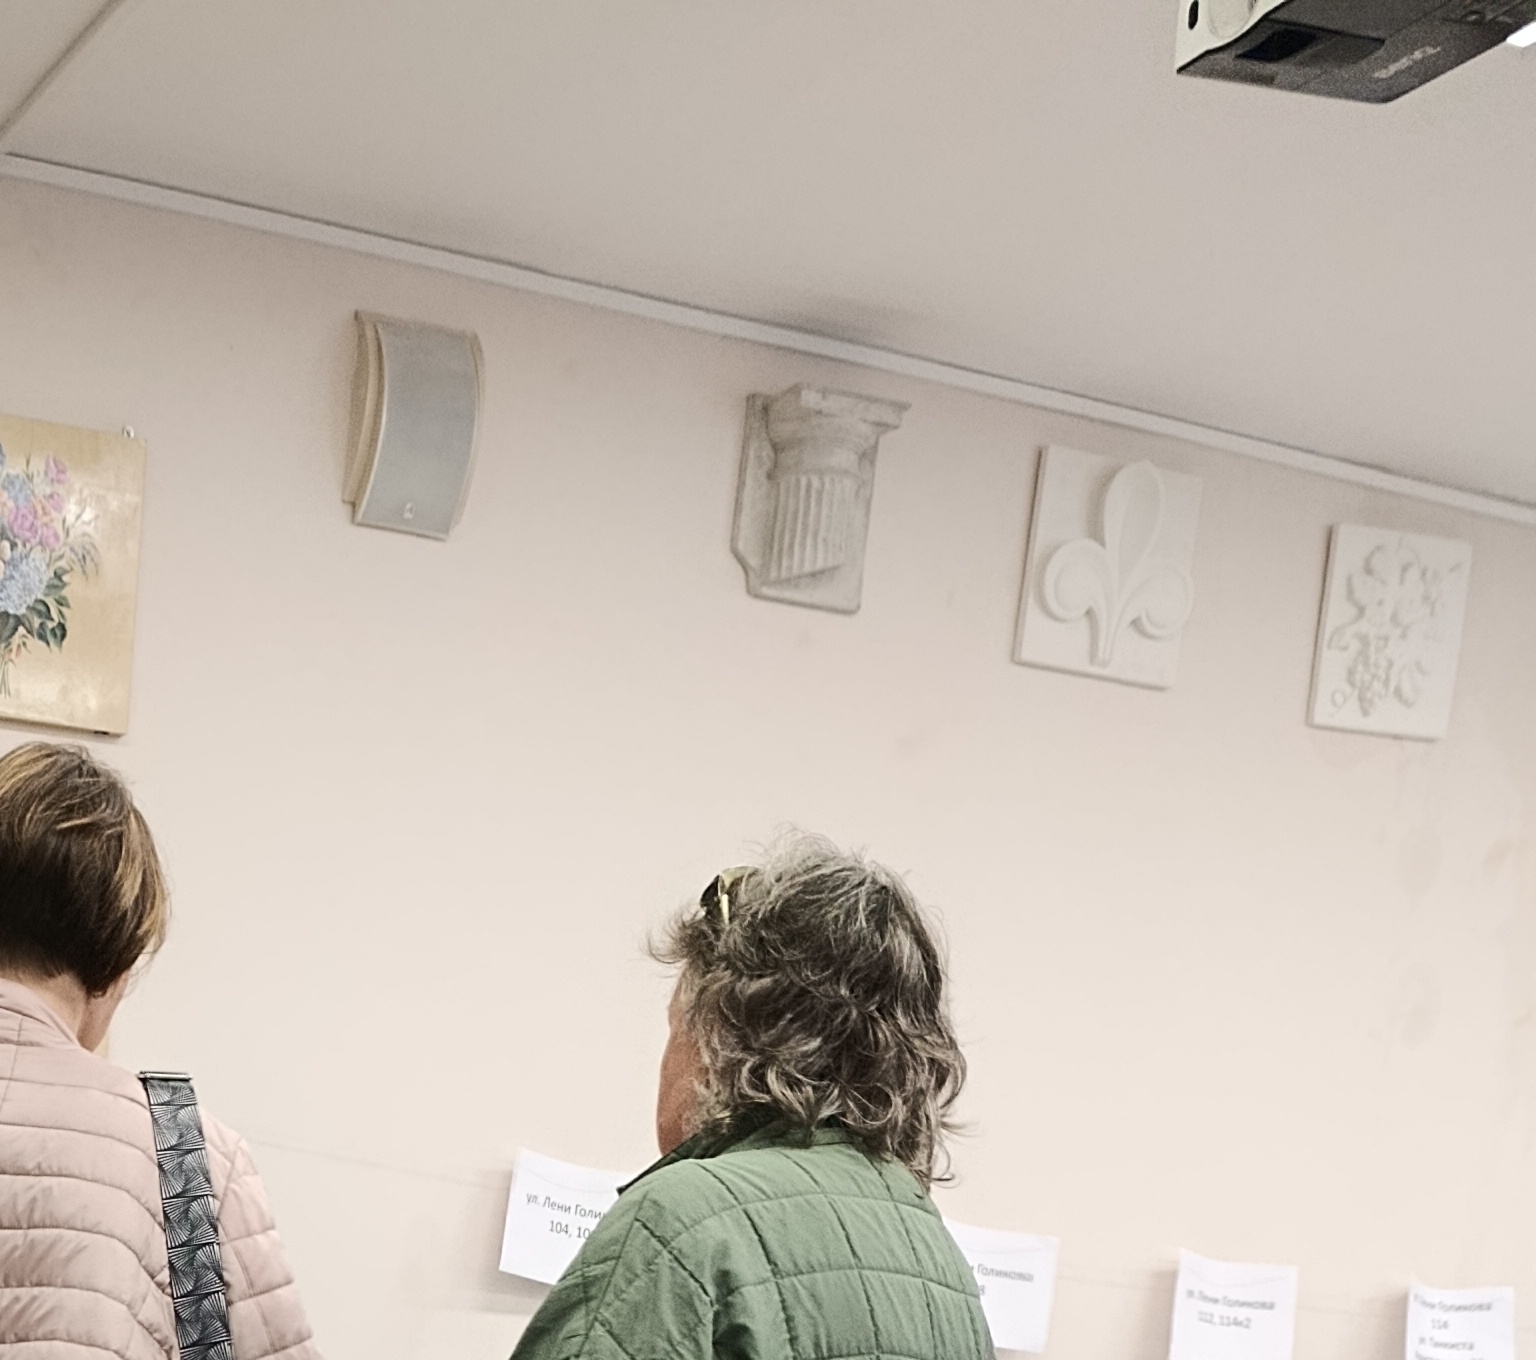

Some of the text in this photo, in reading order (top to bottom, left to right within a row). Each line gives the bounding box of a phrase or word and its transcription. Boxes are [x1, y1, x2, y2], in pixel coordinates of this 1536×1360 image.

[526, 1193, 605, 1220] ул. Лени Голи
[549, 1220, 591, 1240] 104, 10
[1222, 1296, 1276, 1311] Голикова
